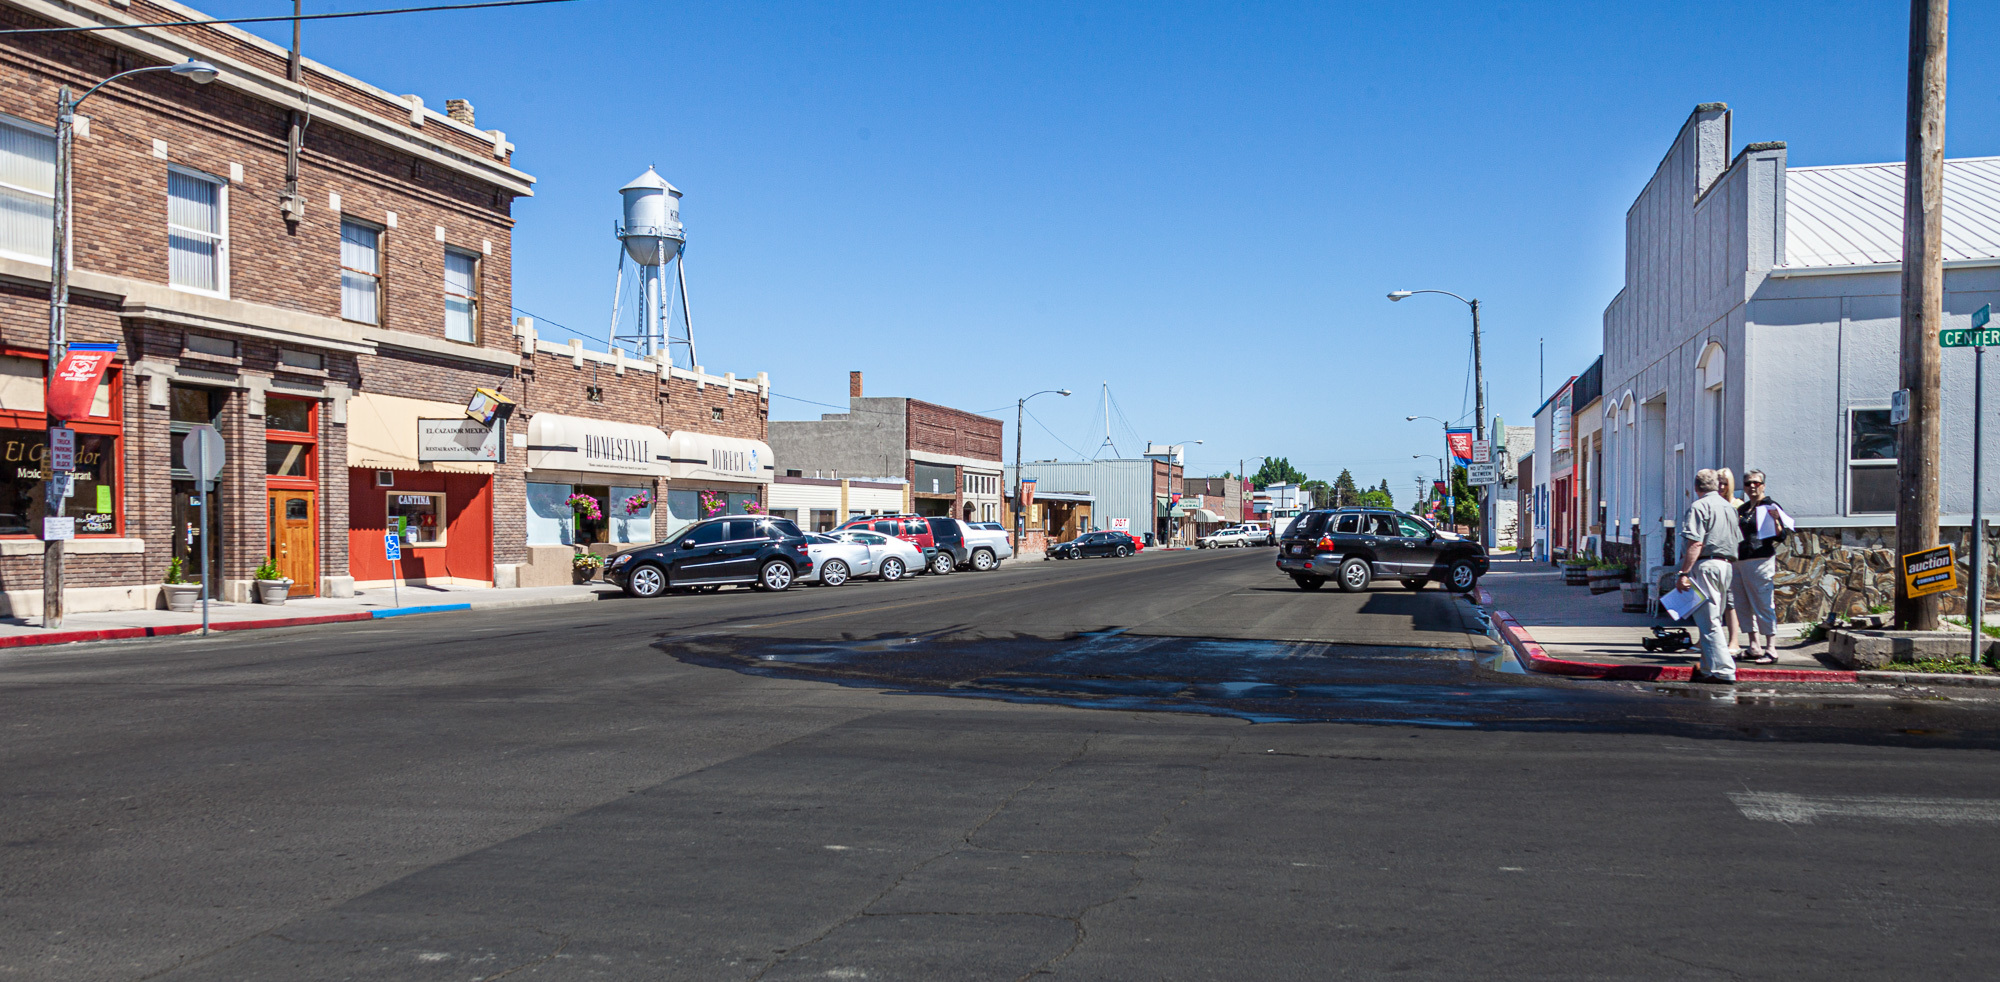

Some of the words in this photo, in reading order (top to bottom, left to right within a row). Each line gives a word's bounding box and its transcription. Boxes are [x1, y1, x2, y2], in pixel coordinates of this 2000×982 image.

[1945, 331, 2000, 346] CENTER
[5, 440, 25, 462] El
[28, 442, 101, 465] Cdor
[586, 434, 650, 463] HOMESTYLE
[712, 448, 744, 472] DIRECT
[17, 467, 42, 479] Mexic
[398, 495, 430, 505] CANTINA
[1908, 556, 1950, 574] auction
[1916, 576, 1935, 585] COMING
[1935, 573, 1949, 581] SOON
